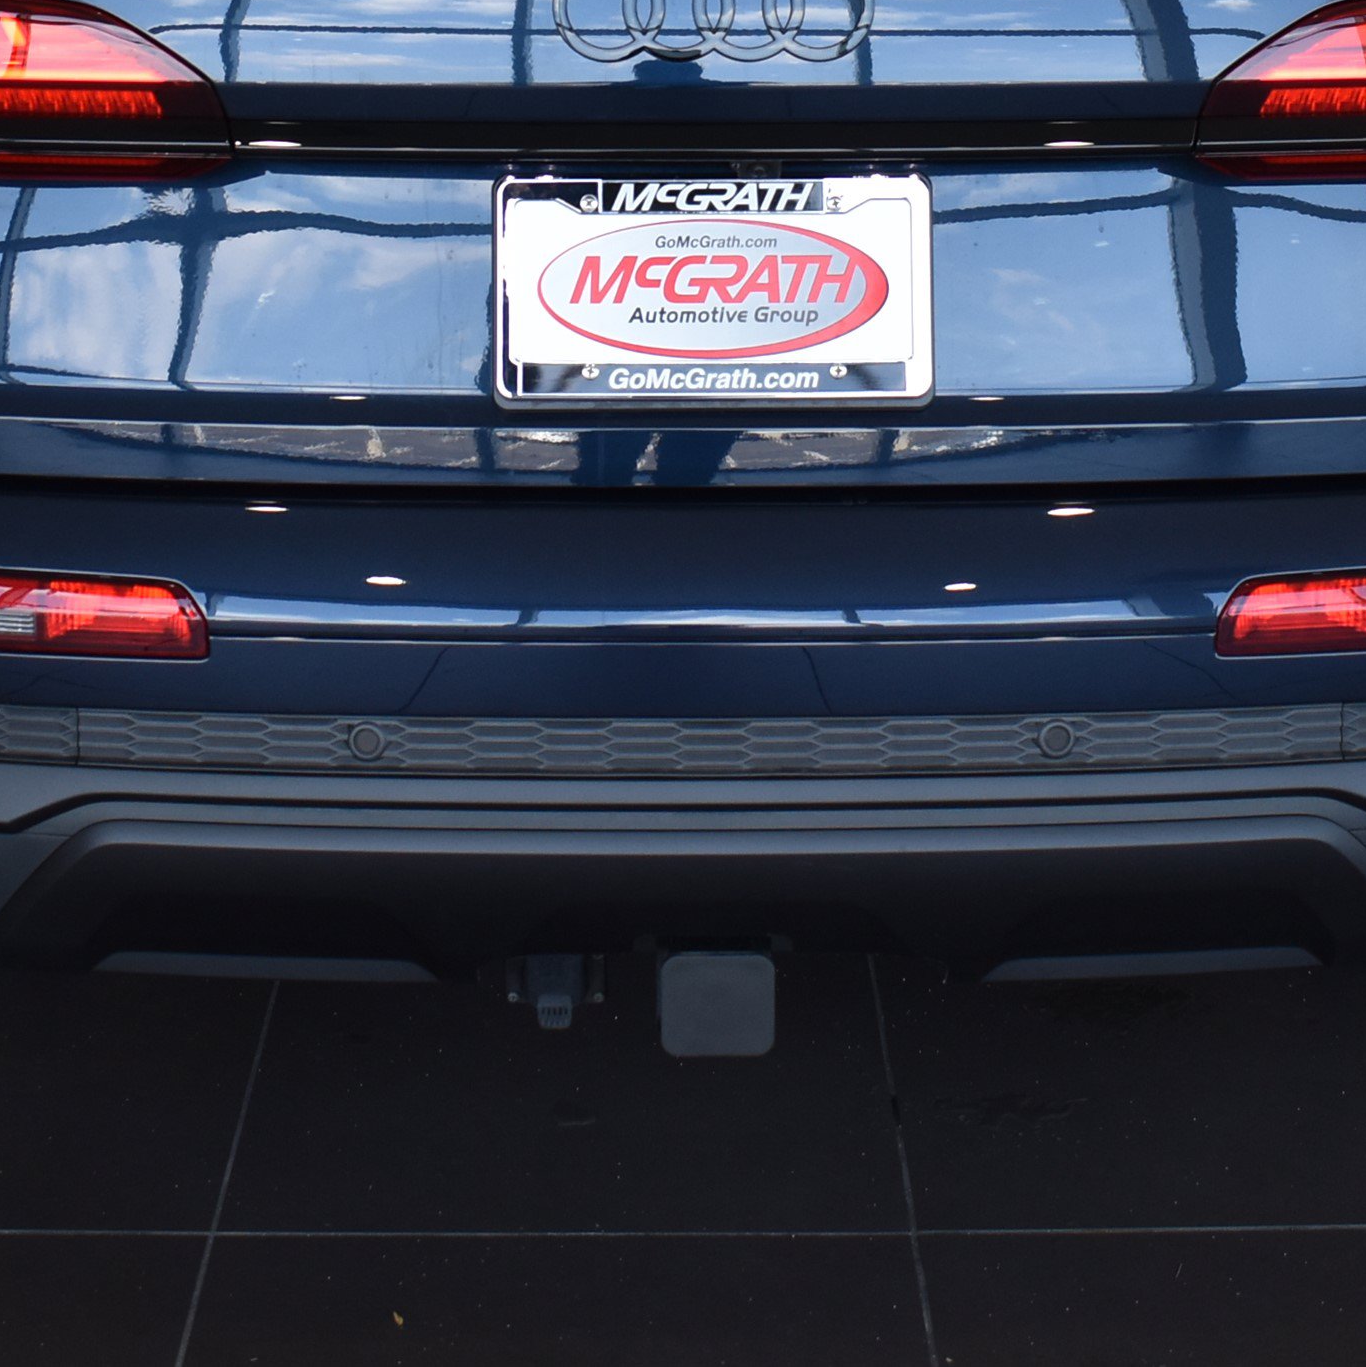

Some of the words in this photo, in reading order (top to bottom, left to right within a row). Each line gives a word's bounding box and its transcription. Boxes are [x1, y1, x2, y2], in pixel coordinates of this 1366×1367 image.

[611, 182, 813, 212] McGRATH
[654, 234, 778, 250] GoMcGrath.com
[569, 254, 858, 305] McGRATH
[628, 305, 748, 325] Automotive
[754, 305, 819, 327] Group
[608, 366, 819, 390] GoMcGrath.com
